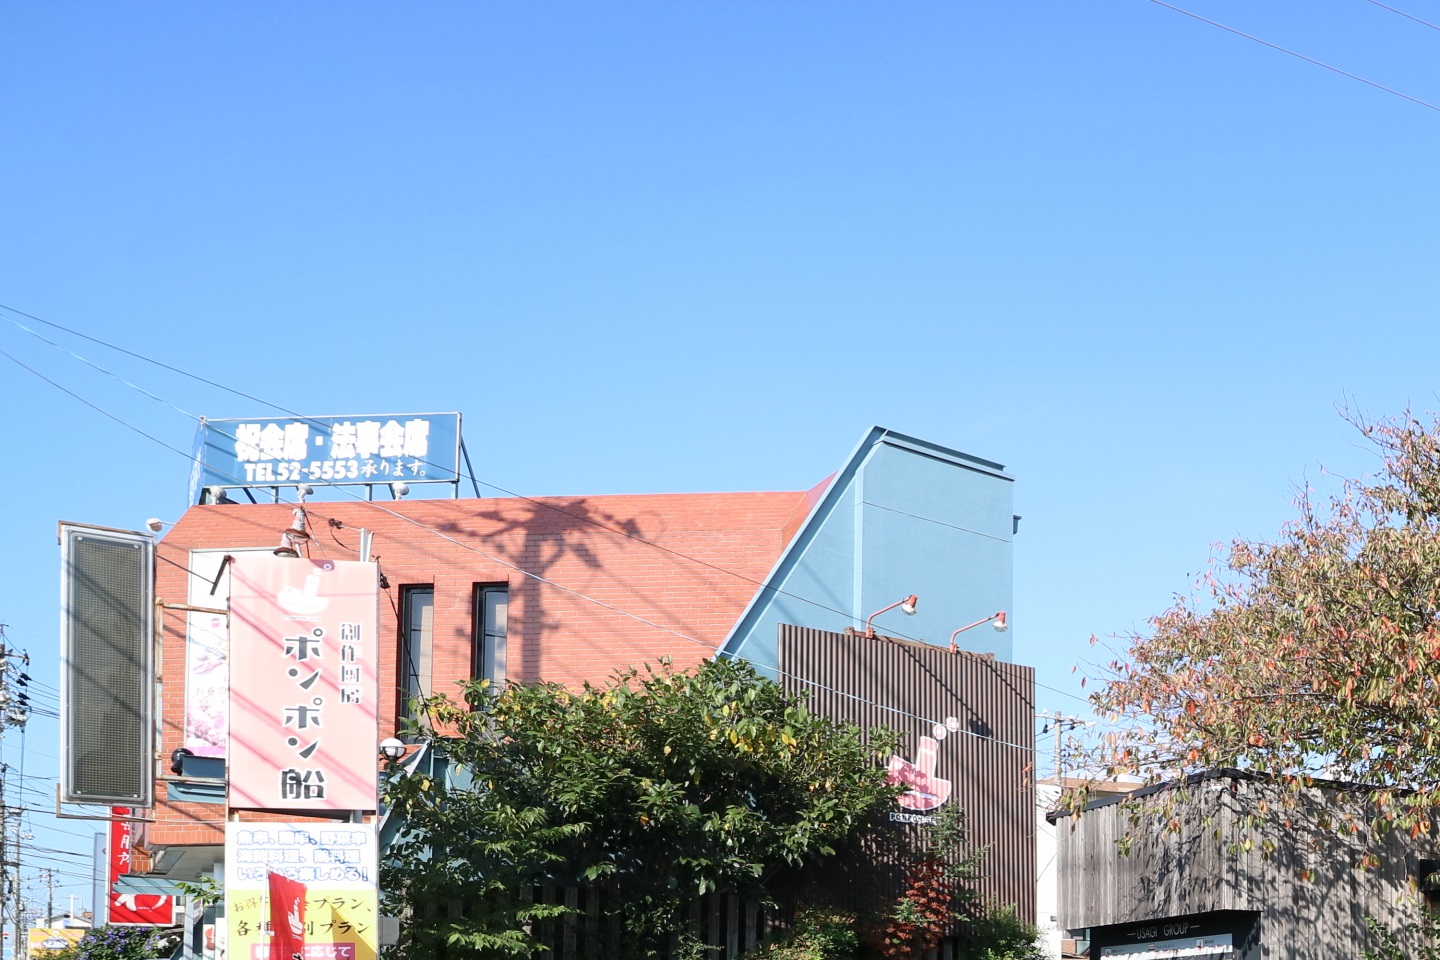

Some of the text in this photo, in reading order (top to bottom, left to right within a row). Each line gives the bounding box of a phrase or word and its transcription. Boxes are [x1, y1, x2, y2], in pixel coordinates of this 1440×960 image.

[281, 627, 326, 800] ポンポン船
[1163, 923, 1189, 936] GROUP
